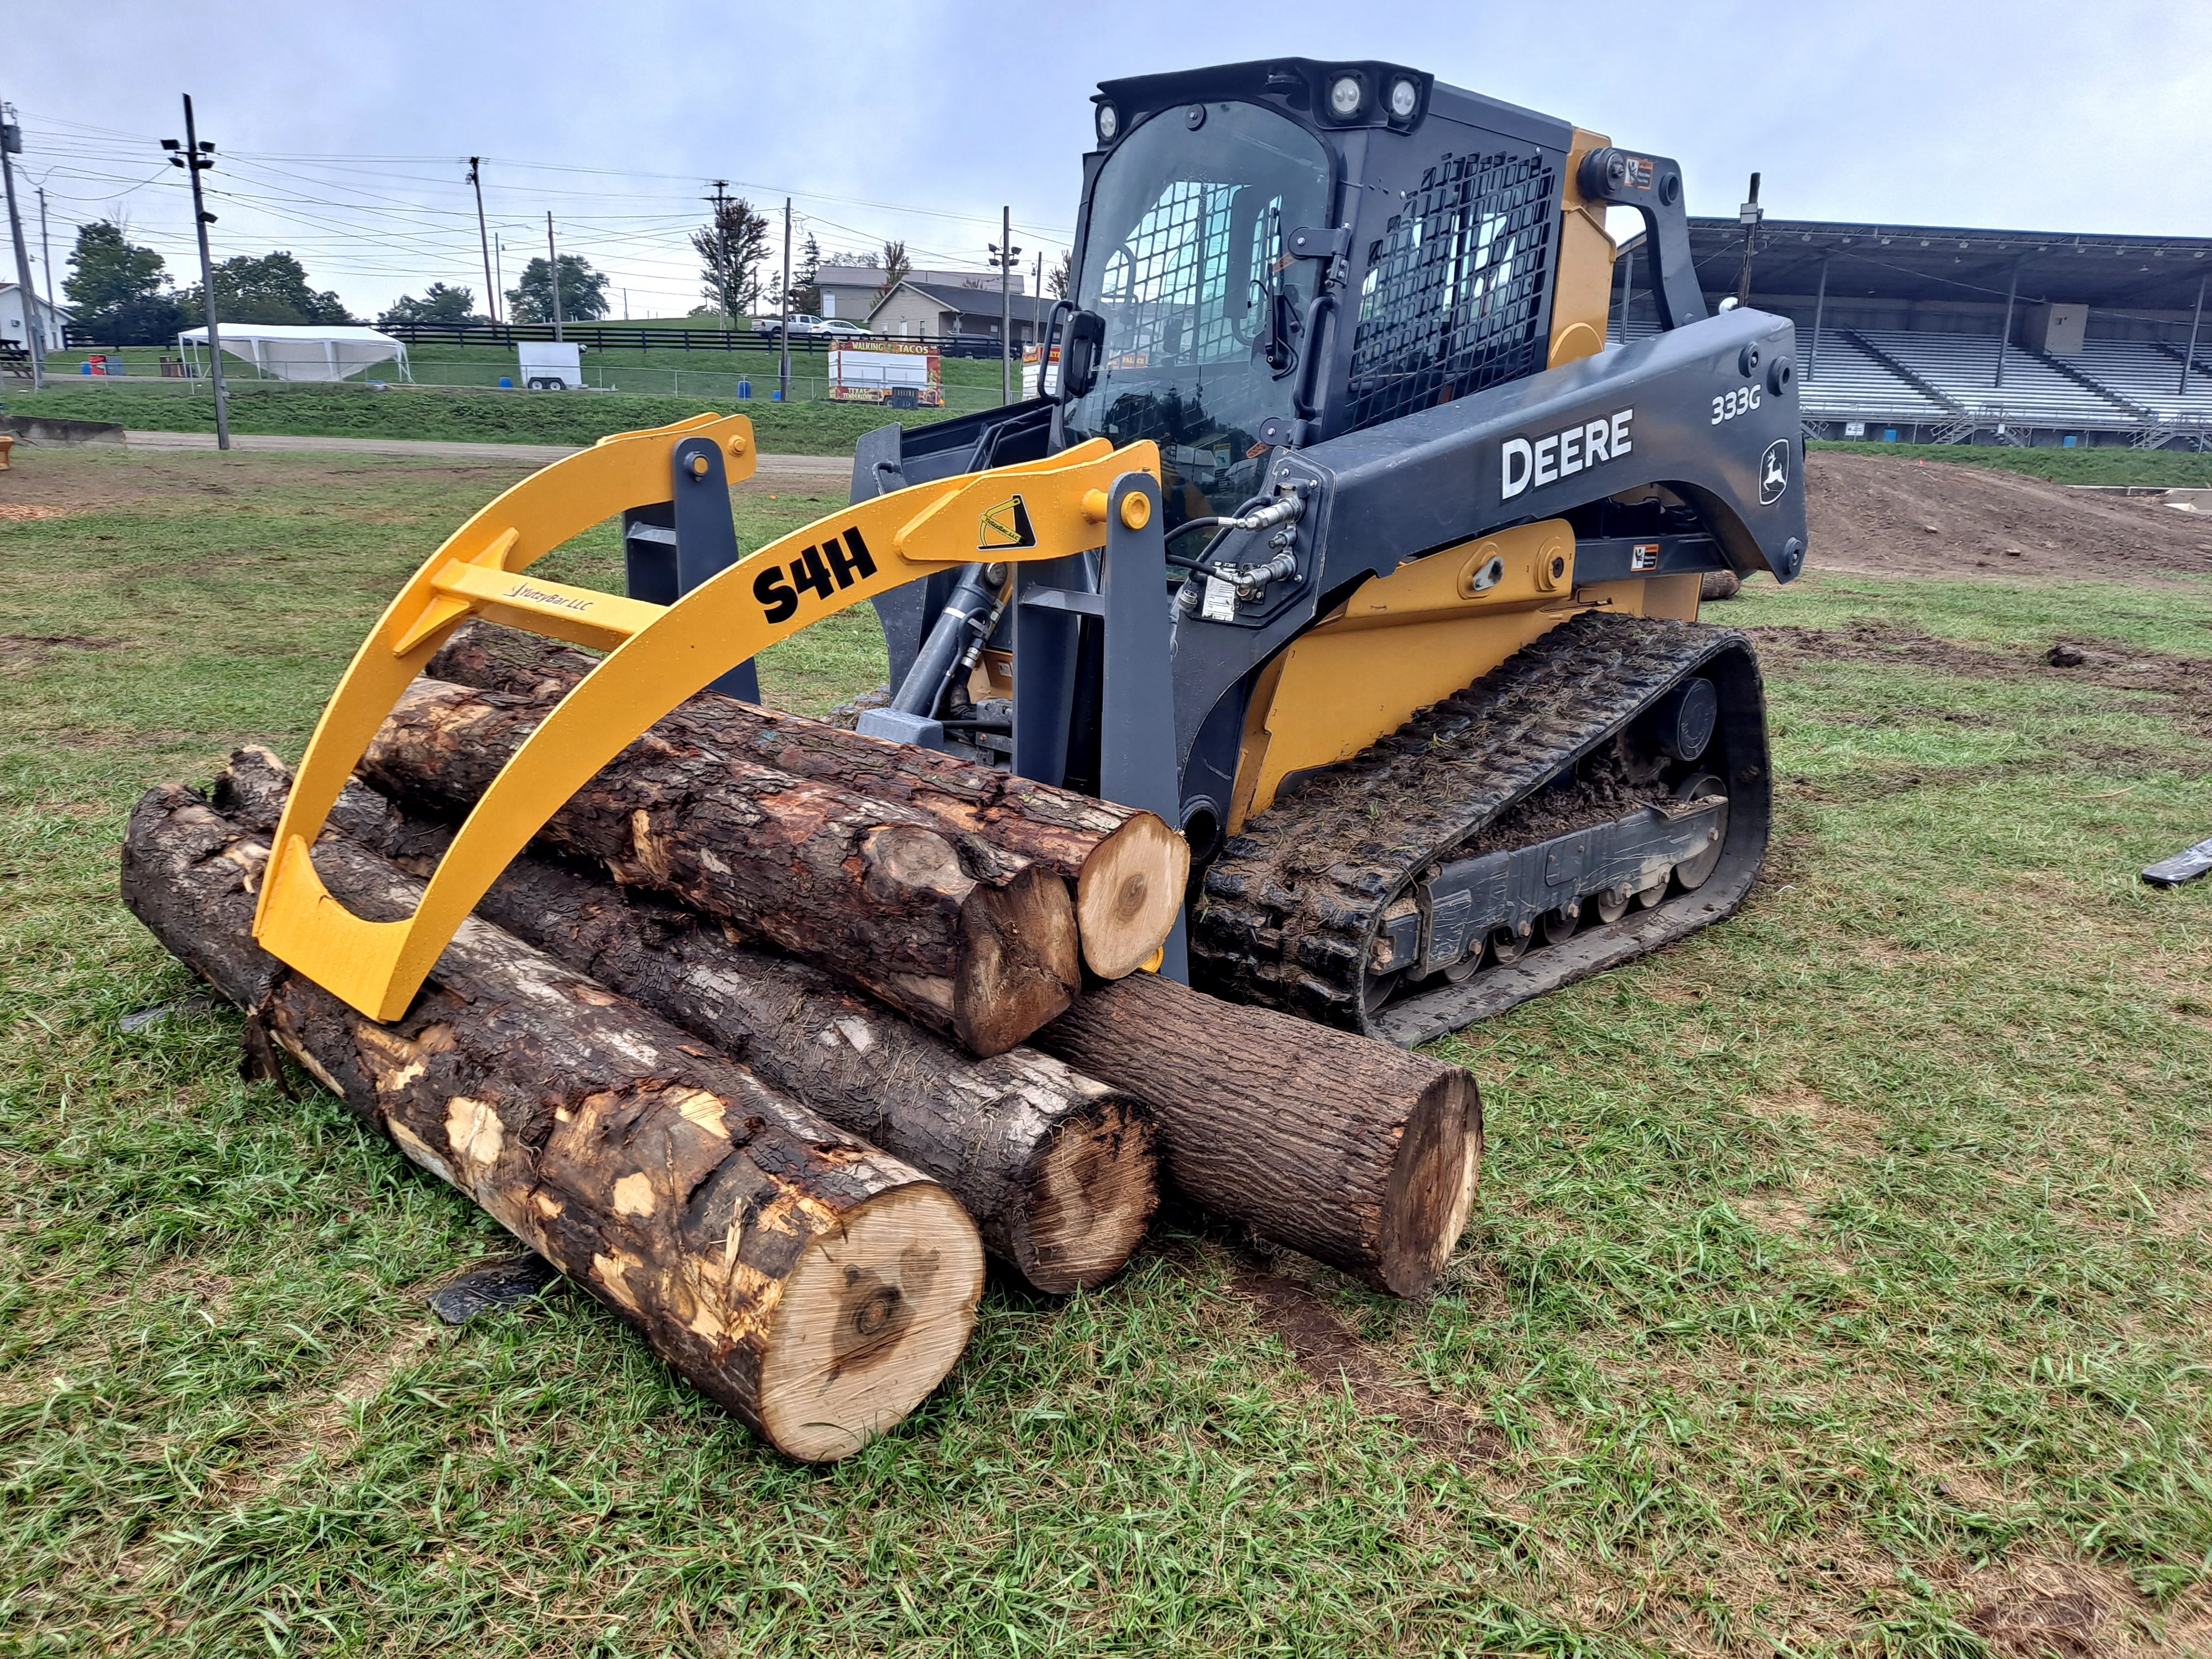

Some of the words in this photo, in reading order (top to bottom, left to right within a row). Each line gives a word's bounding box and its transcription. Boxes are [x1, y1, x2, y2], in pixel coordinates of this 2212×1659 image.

[852, 342, 884, 352] WALKING
[898, 344, 929, 354] TACOS
[1710, 384, 1761, 426] 333G
[1502, 409, 1633, 499] DEERE
[753, 525, 878, 624] S4H
[519, 587, 569, 605] YutzyBar
[566, 599, 594, 611] LLC
